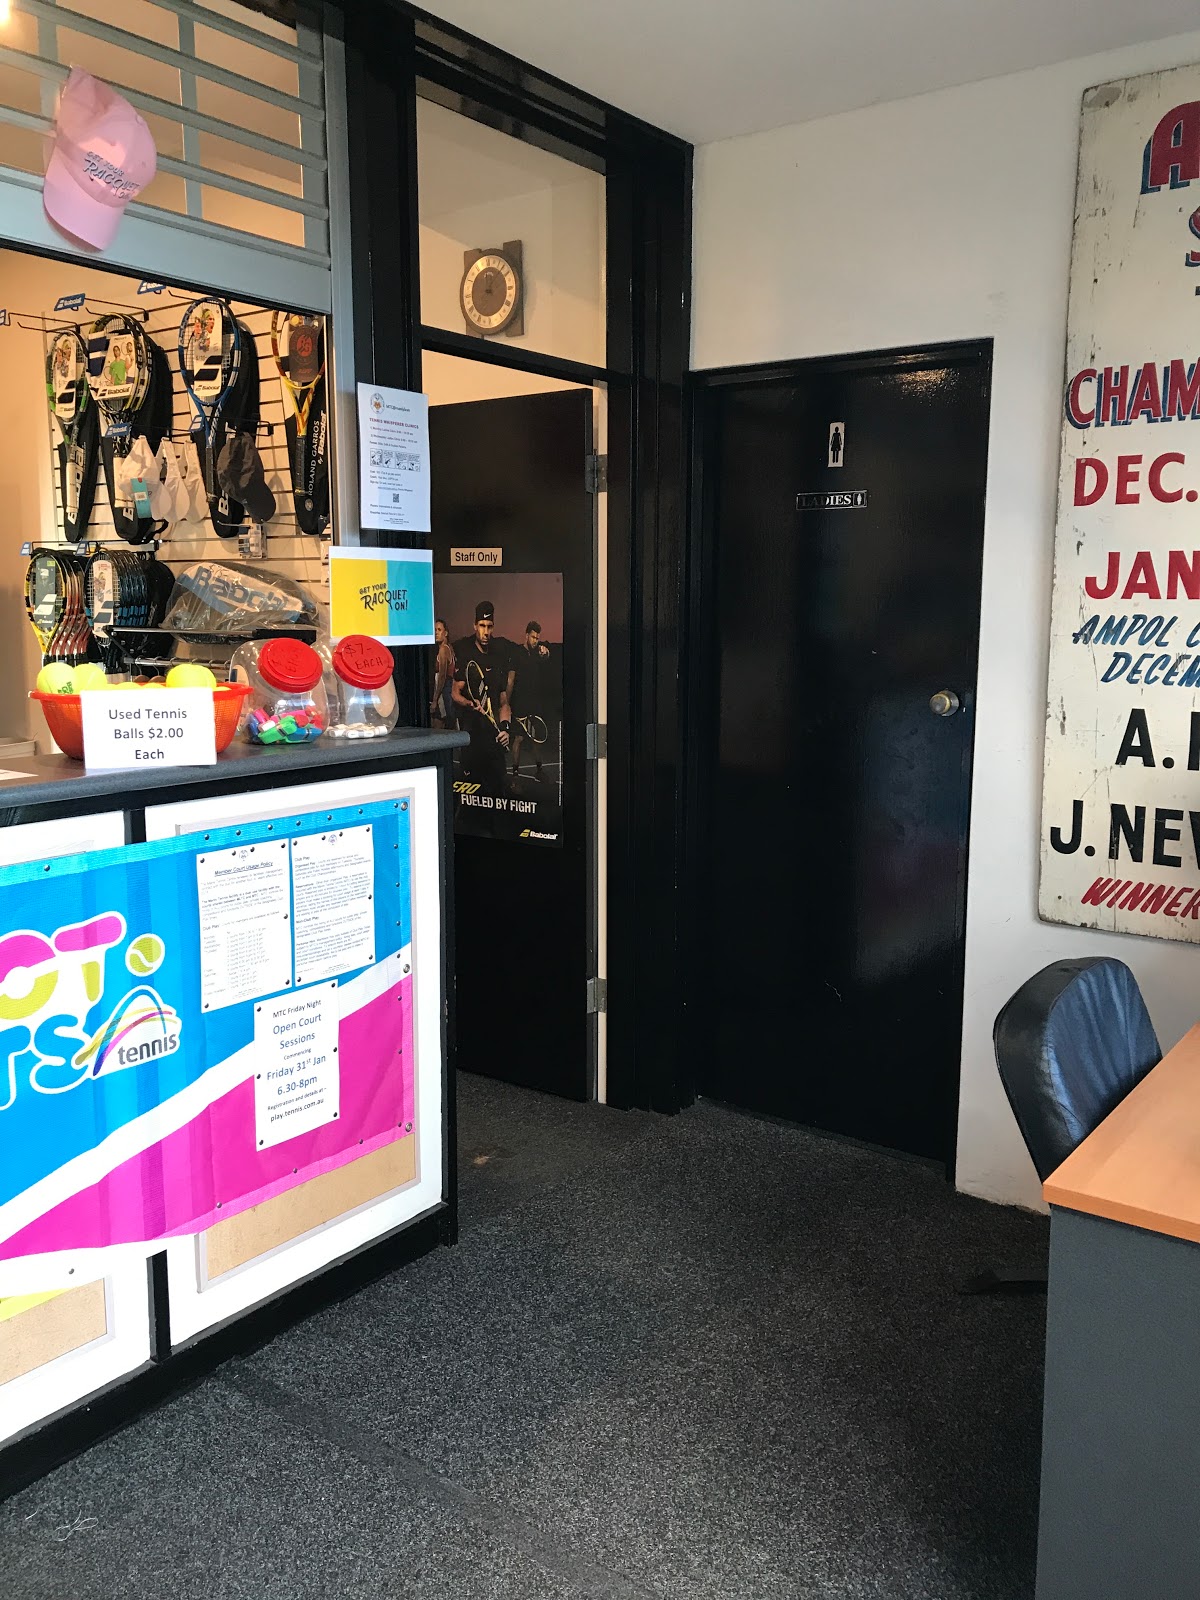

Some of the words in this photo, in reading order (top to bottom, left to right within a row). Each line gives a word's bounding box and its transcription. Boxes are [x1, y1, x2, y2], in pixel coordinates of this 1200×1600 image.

[83, 158, 140, 197] RACQUET
[104, 161, 124, 177] YOUR
[311, 420, 320, 457] GARROS
[318, 410, 327, 456] Babolat
[308, 460, 317, 496] ROLAND
[1073, 452, 1199, 507] DEC.
[801, 494, 852, 507] LADIES
[455, 551, 476, 562] Staff
[477, 551, 498, 564] Only
[1084, 550, 1200, 600] JAN
[359, 587, 371, 595] GET
[372, 583, 387, 591] YOUR
[360, 589, 408, 611] RACQUET
[394, 600, 408, 611] ON!
[1072, 614, 1179, 648] AMPOL
[354, 657, 383, 669] EACH
[108, 708, 141, 720] Used
[145, 708, 188, 719] Tennis
[114, 728, 144, 739] Balls
[148, 727, 184, 740] $2.00
[135, 749, 165, 760] Each
[461, 794, 494, 809] FUELED
[496, 798, 508, 810] BY
[510, 800, 537, 814] FIGHT
[530, 830, 558, 840] Babolat
[273, 1009, 287, 1018] MTC
[288, 1005, 306, 1014] Friday
[306, 1000, 322, 1009] Night
[273, 1022, 297, 1035] Open
[299, 1014, 322, 1027] Court
[117, 1032, 178, 1066] tennis
[280, 1033, 316, 1049] Sessions
[284, 1048, 312, 1060] Commencing
[267, 1066, 295, 1080] Friday
[297, 1058, 312, 1072] 31st
[313, 1055, 326, 1066] Jan
[277, 1076, 318, 1095] 6.30-8pm
[267, 1098, 295, 1111] Registration
[304, 1089, 318, 1099] details
[270, 1098, 325, 1123] play.tennis.com.au
